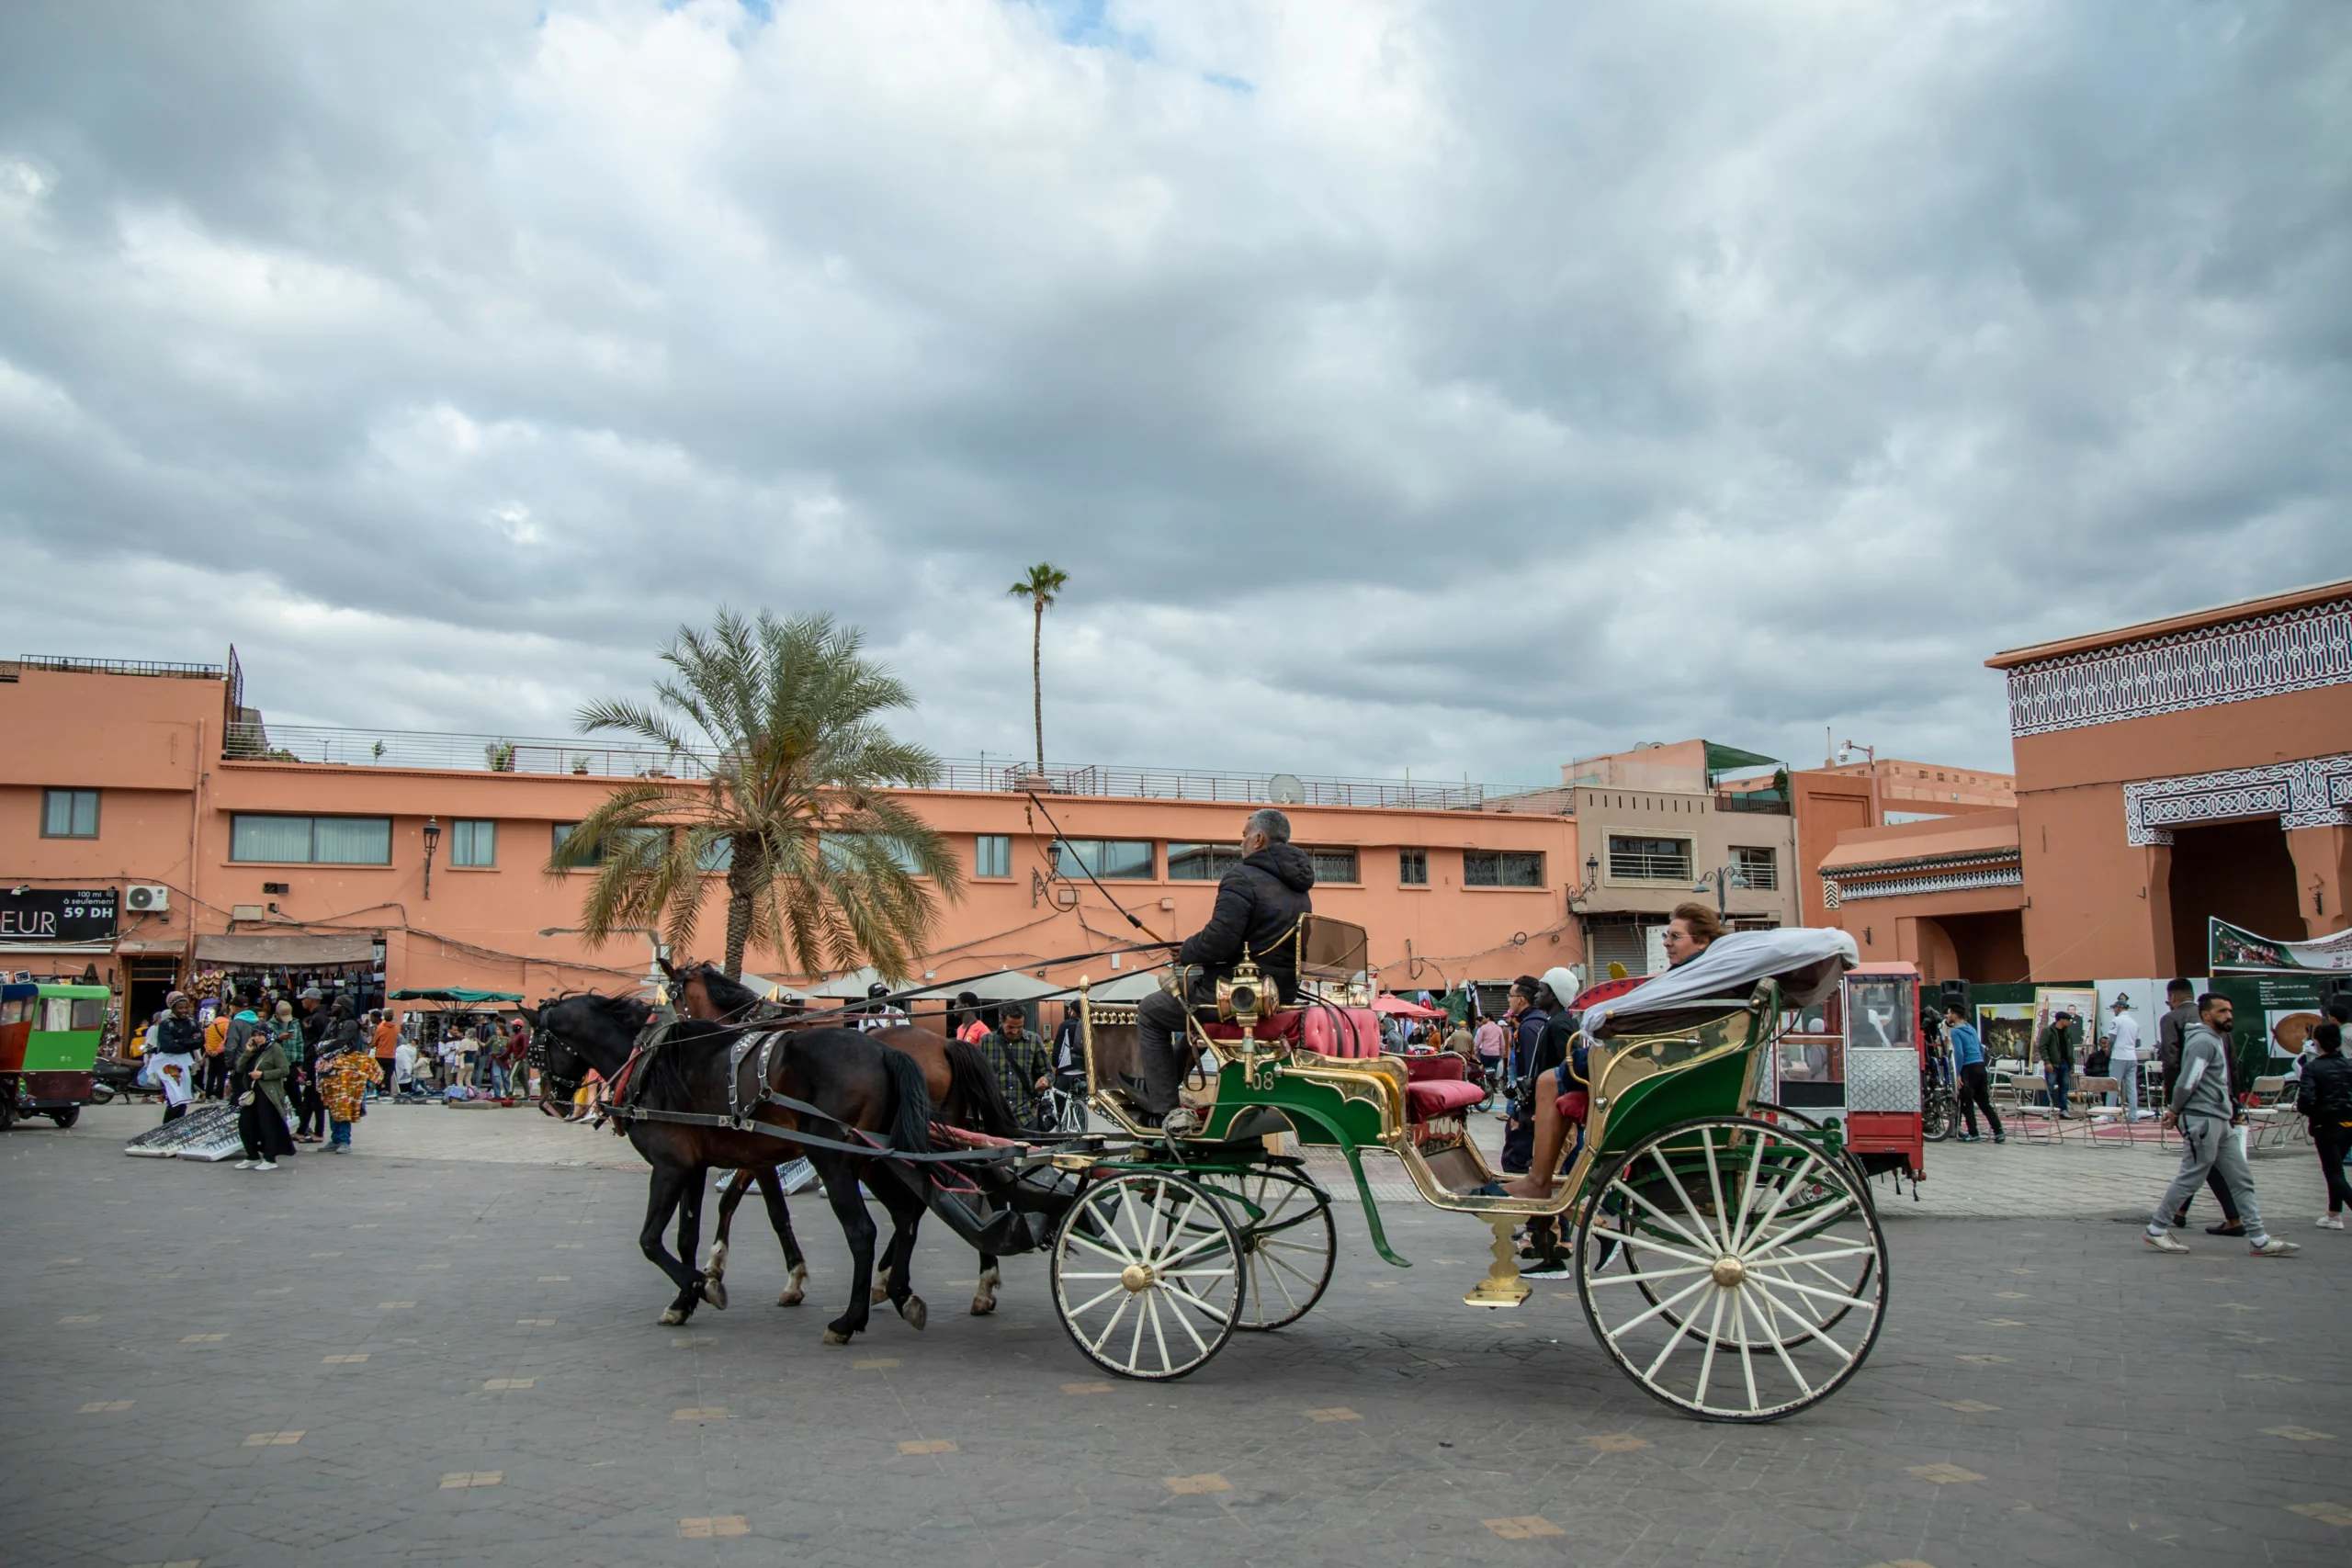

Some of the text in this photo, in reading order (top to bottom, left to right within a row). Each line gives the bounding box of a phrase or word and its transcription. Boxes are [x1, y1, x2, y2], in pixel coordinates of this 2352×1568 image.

[0, 911, 55, 934] EUR
[63, 907, 113, 919] 59 DH
[1243, 1071, 1274, 1090] 08
